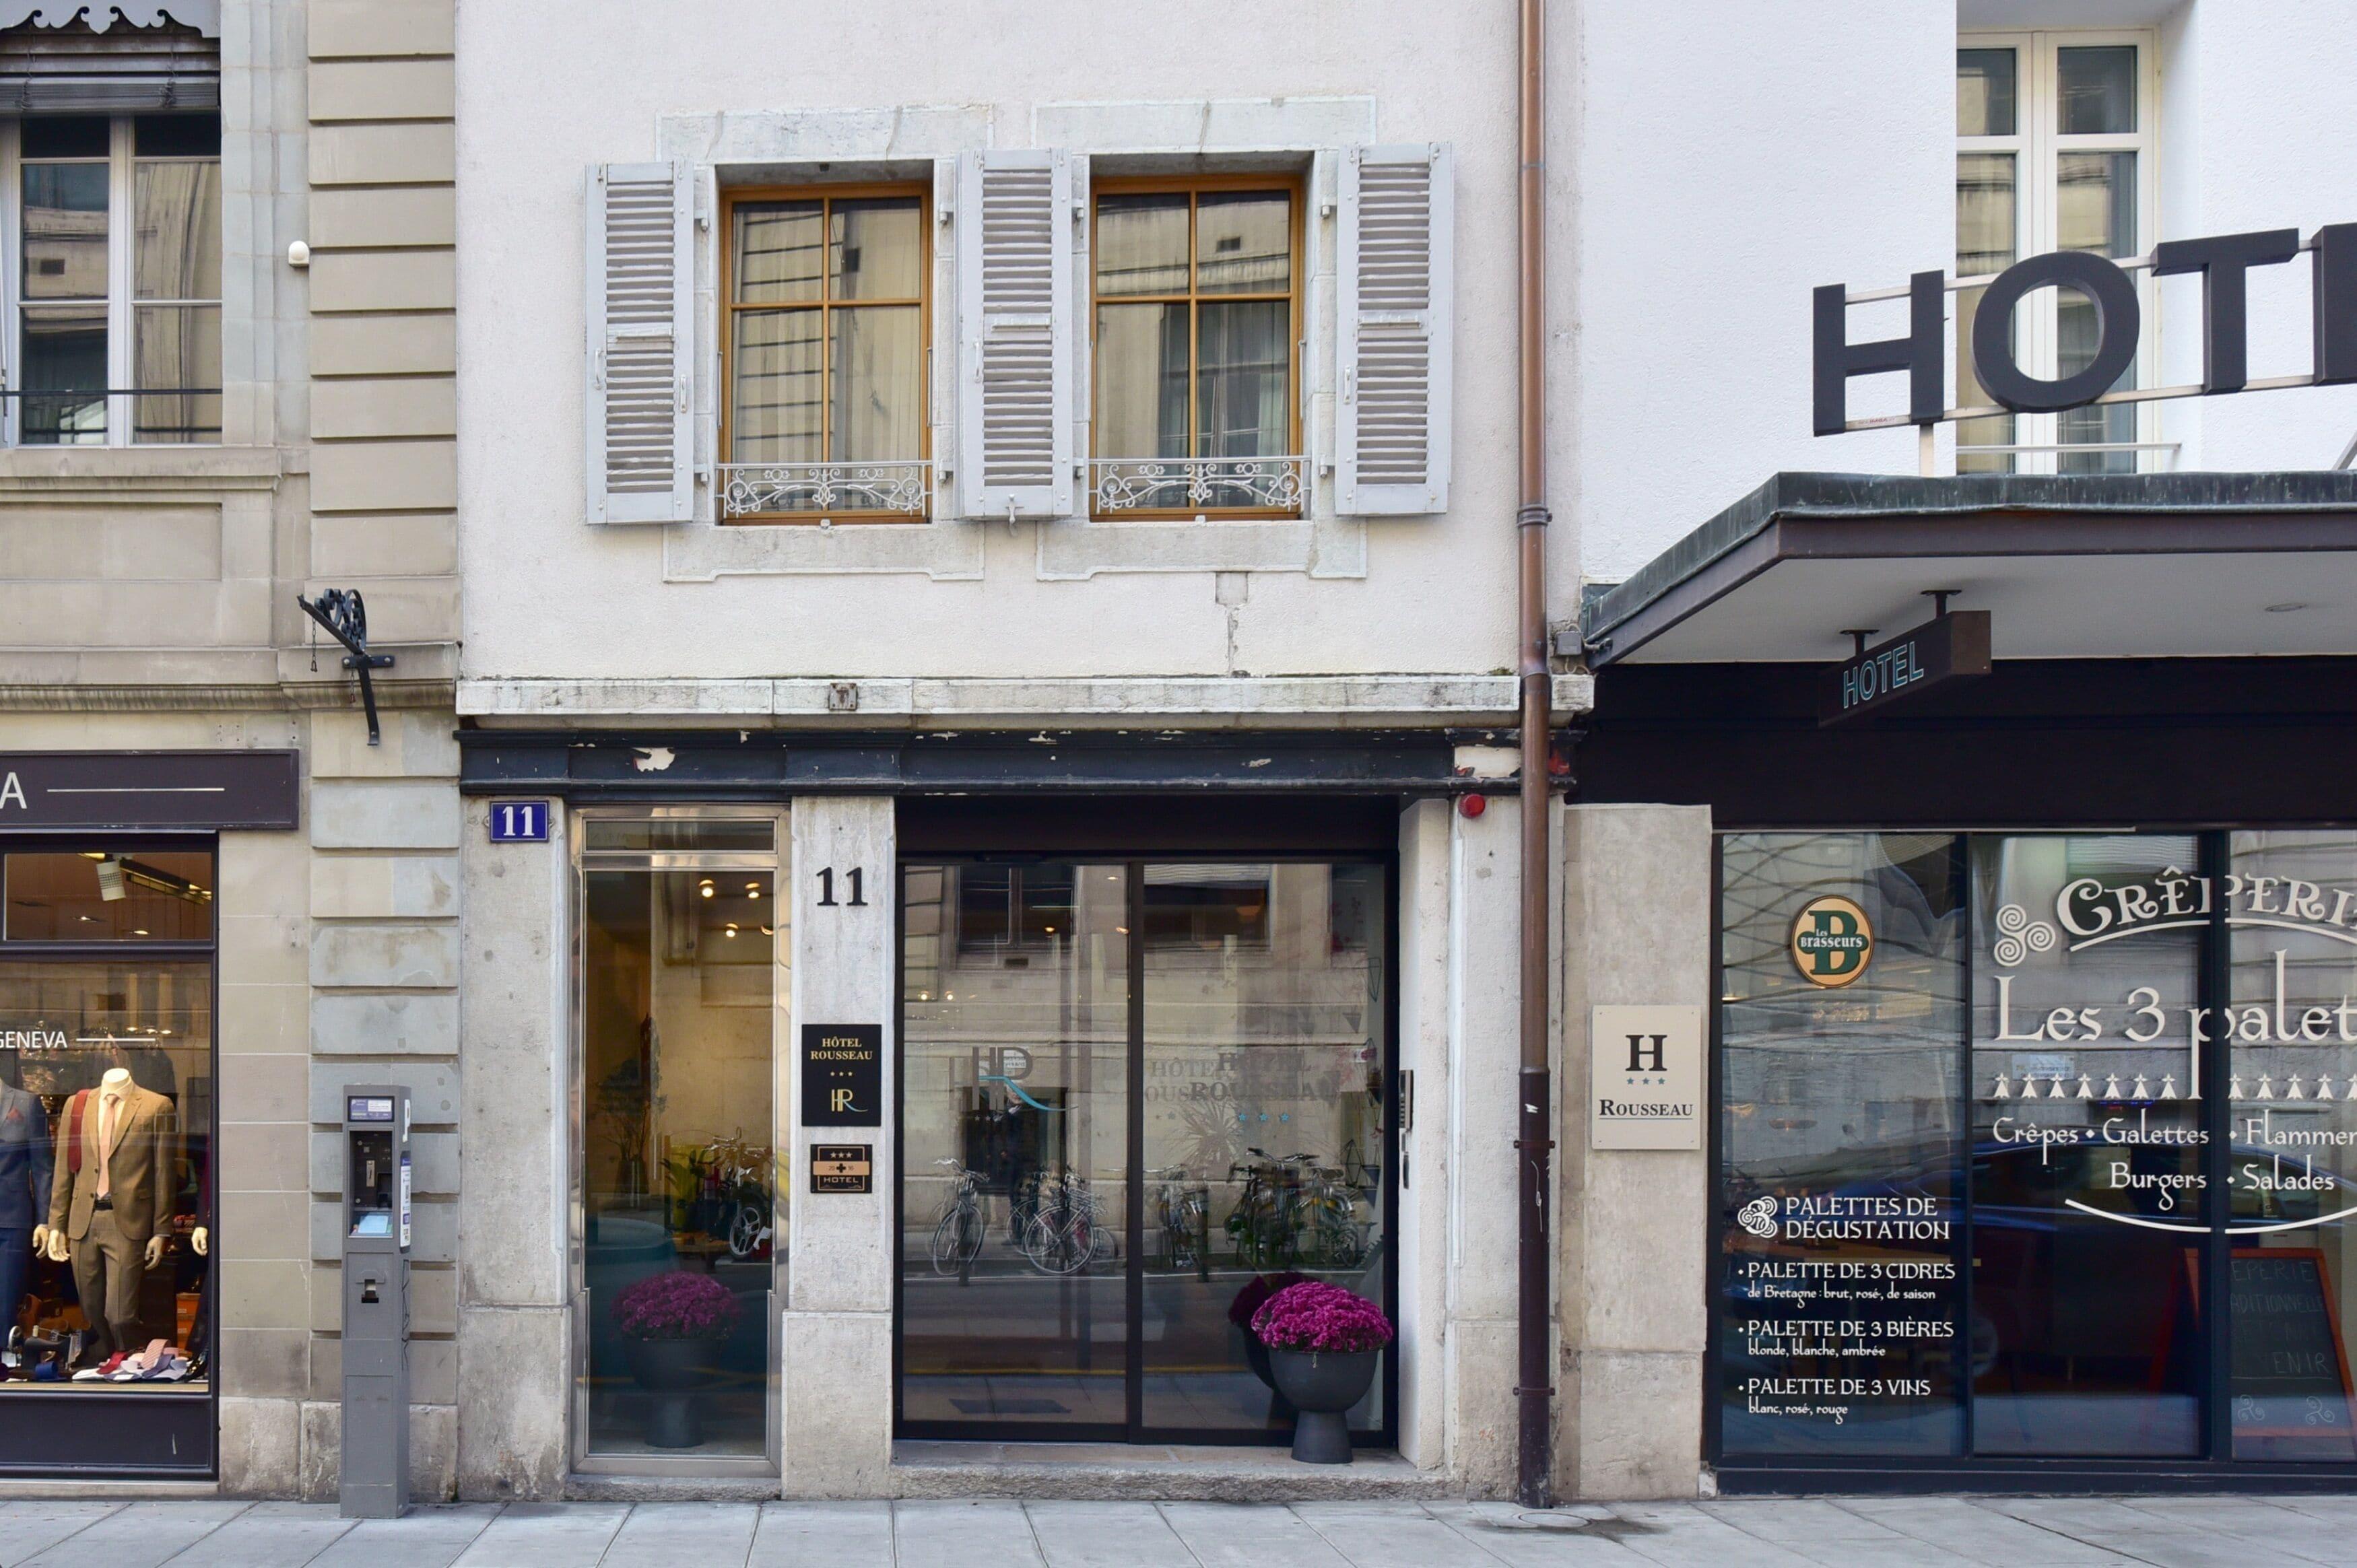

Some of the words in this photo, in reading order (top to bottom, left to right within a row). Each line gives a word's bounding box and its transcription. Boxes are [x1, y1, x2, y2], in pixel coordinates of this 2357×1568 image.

[1813, 223, 2357, 436] HOT
[1843, 641, 1924, 709] HOTEL
[0, 772, 27, 809] A
[502, 806, 535, 836] 11
[816, 866, 868, 906] 11
[2057, 864, 2357, 936] CRÊPERI
[1800, 936, 1863, 948] Brasseurs
[1816, 928, 1828, 937] Les
[1994, 975, 2102, 1042] Les
[2125, 986, 2166, 1042] 3
[810, 1050, 873, 1060] ROUSSEAU
[822, 1035, 862, 1048] HÔTEL
[1625, 1034, 1668, 1072] H
[1993, 1117, 2079, 1165] Crêpes
[2102, 1107, 2210, 1145] Galettes
[2109, 1161, 2207, 1211] Burgers
[2242, 1154, 2335, 1191] Salades
[1787, 1198, 1900, 1216] PALETTES
[1907, 1198, 1937, 1215] DE
[1786, 1217, 1950, 1239] DÉGUSTATION
[1749, 1262, 1834, 1278] PALETTE
[1840, 1263, 1865, 1278] DE
[1871, 1264, 1881, 1278] 3
[1886, 1264, 1955, 1279] CIDRES
[1748, 1281, 1760, 1297] de
[1765, 1285, 1816, 1308] Bretagne
[1824, 1281, 1852, 1299] brut,
[1888, 1282, 1899, 1298] de
[1904, 1290, 1935, 1298] saison
[1749, 1320, 1834, 1336] PALETTE
[1841, 1321, 1865, 1336] DE
[1871, 1322, 1882, 1336] 3
[1888, 1316, 1953, 1336] BIÈRES
[1749, 1338, 1789, 1356] blonde,
[1793, 1338, 1838, 1357] blanche,
[1843, 1339, 1885, 1355] ambrée
[1749, 1379, 1835, 1394] PALETTE
[1841, 1379, 1866, 1394] DE
[1871, 1380, 1882, 1395] 3
[1888, 1380, 1930, 1395] VINS
[1749, 1396, 1782, 1414] blanc,
[1817, 1407, 1847, 1424] rouge
